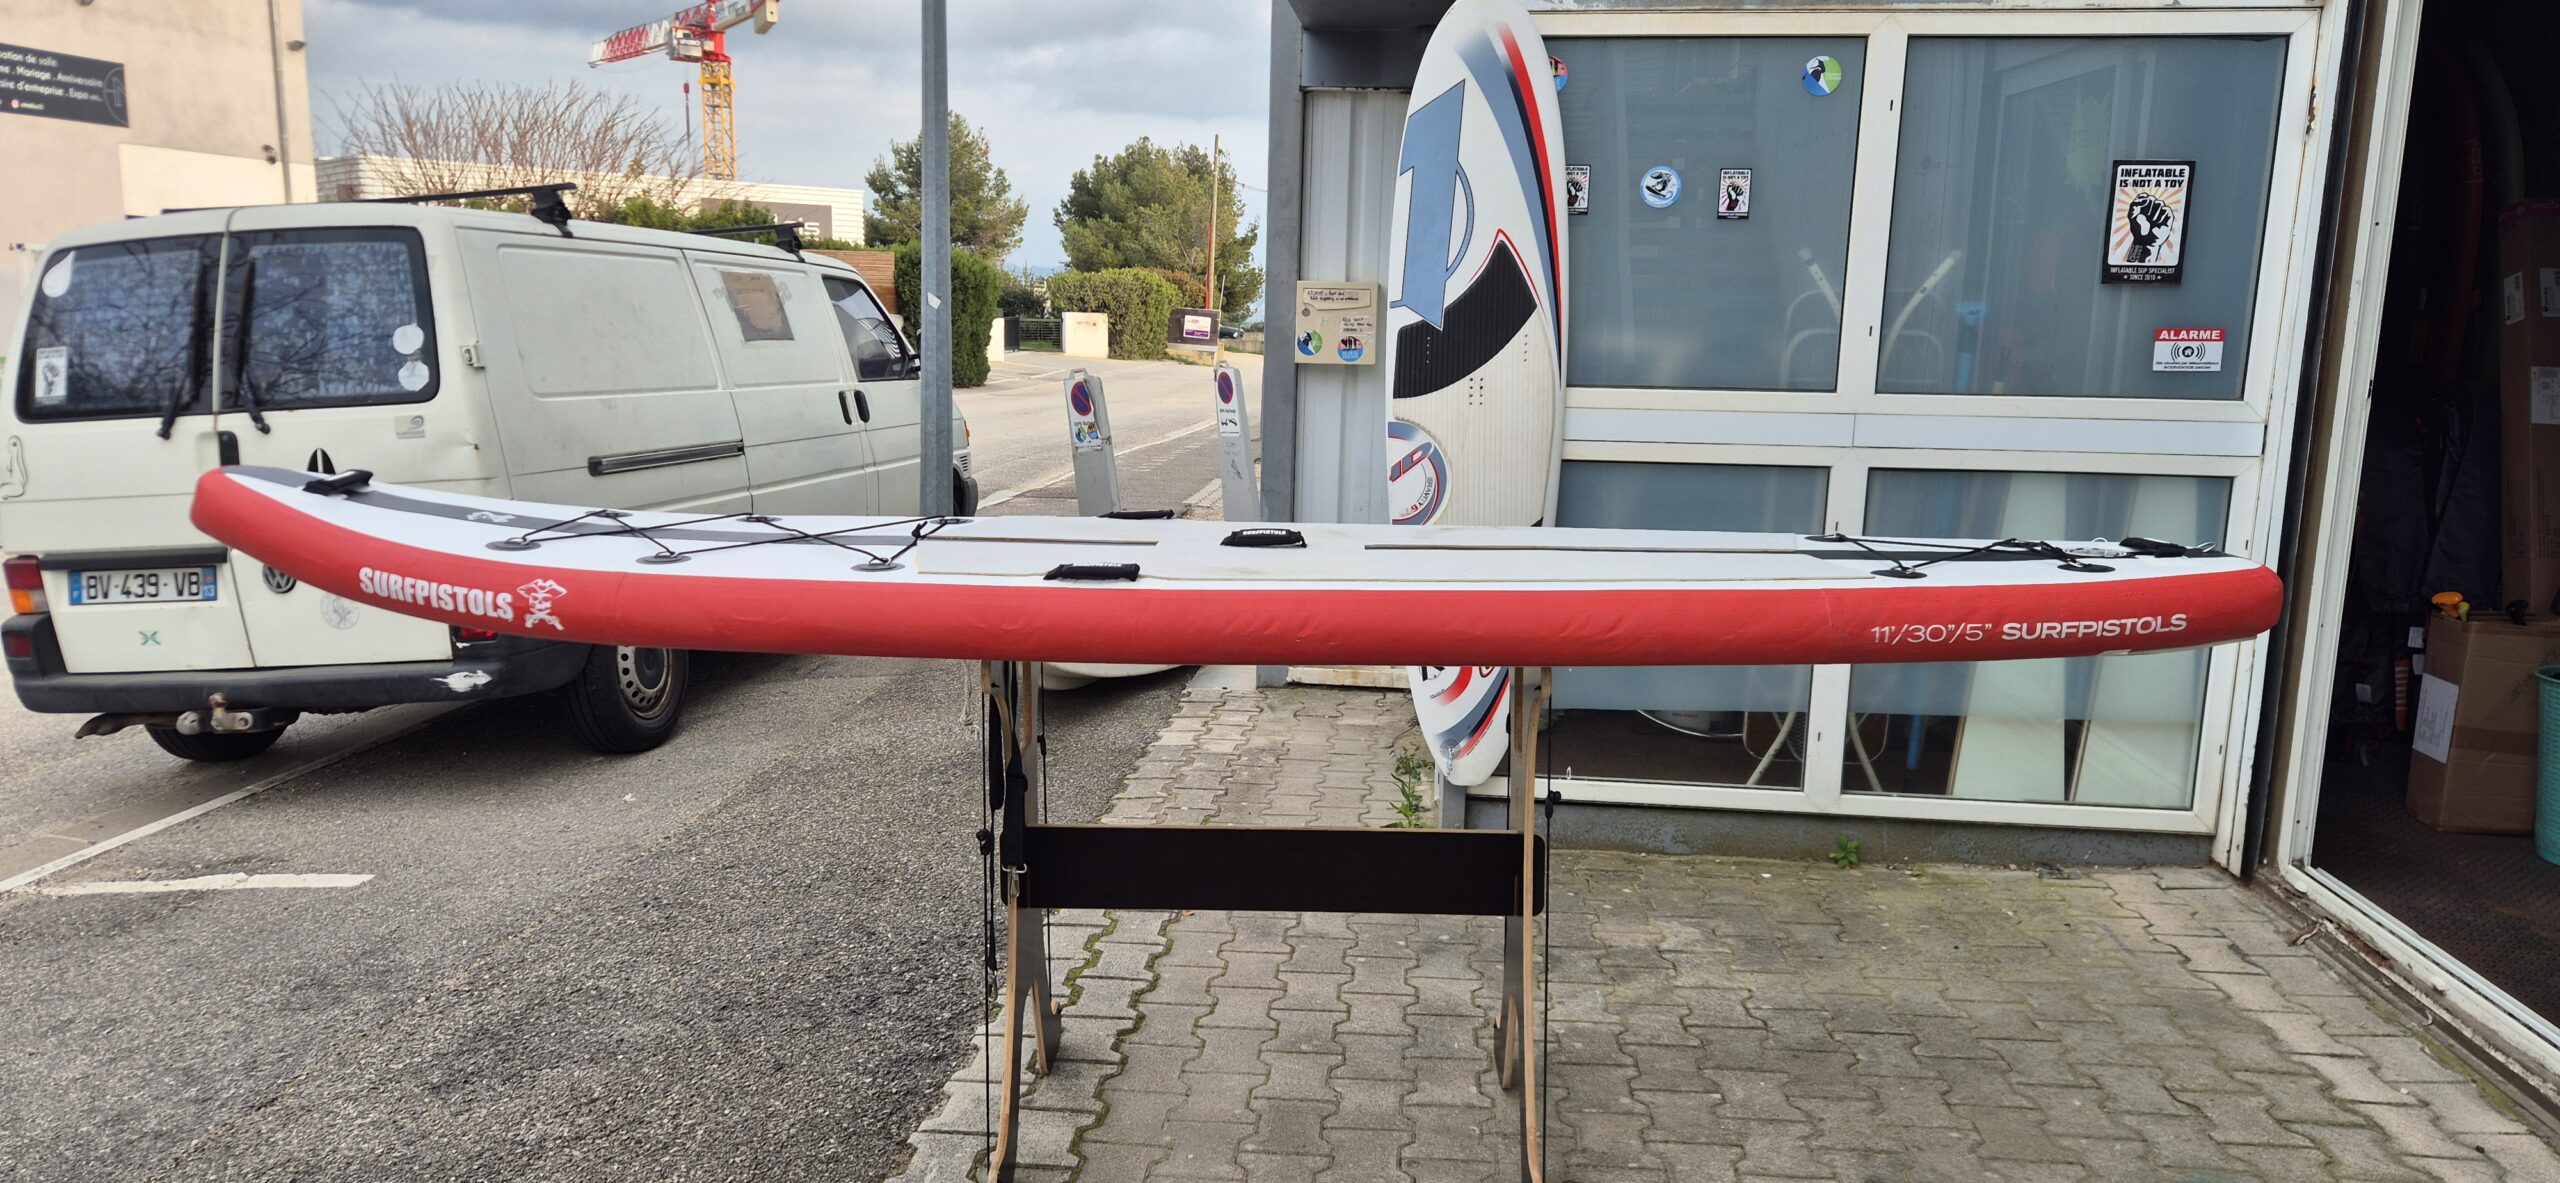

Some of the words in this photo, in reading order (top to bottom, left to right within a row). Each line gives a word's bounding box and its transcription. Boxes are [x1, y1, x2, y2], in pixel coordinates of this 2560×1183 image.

[26, 54, 36, 64] de
[39, 56, 58, 67] salle
[16, 66, 51, 80] Mariage
[57, 72, 103, 87] Anniversaire
[17, 81, 64, 96] d'entreprise
[69, 88, 88, 100] Expo
[2120, 168, 2186, 178] INFLATABLE
[2119, 180, 2128, 188] IS
[2132, 180, 2152, 188] NOT
[2155, 180, 2162, 188] A
[2164, 180, 2184, 188] TOY
[2159, 330, 2221, 340] ALARME
[358, 567, 514, 622] SURFPISTOLS
[2001, 614, 2187, 641] SURFPISTOLS
